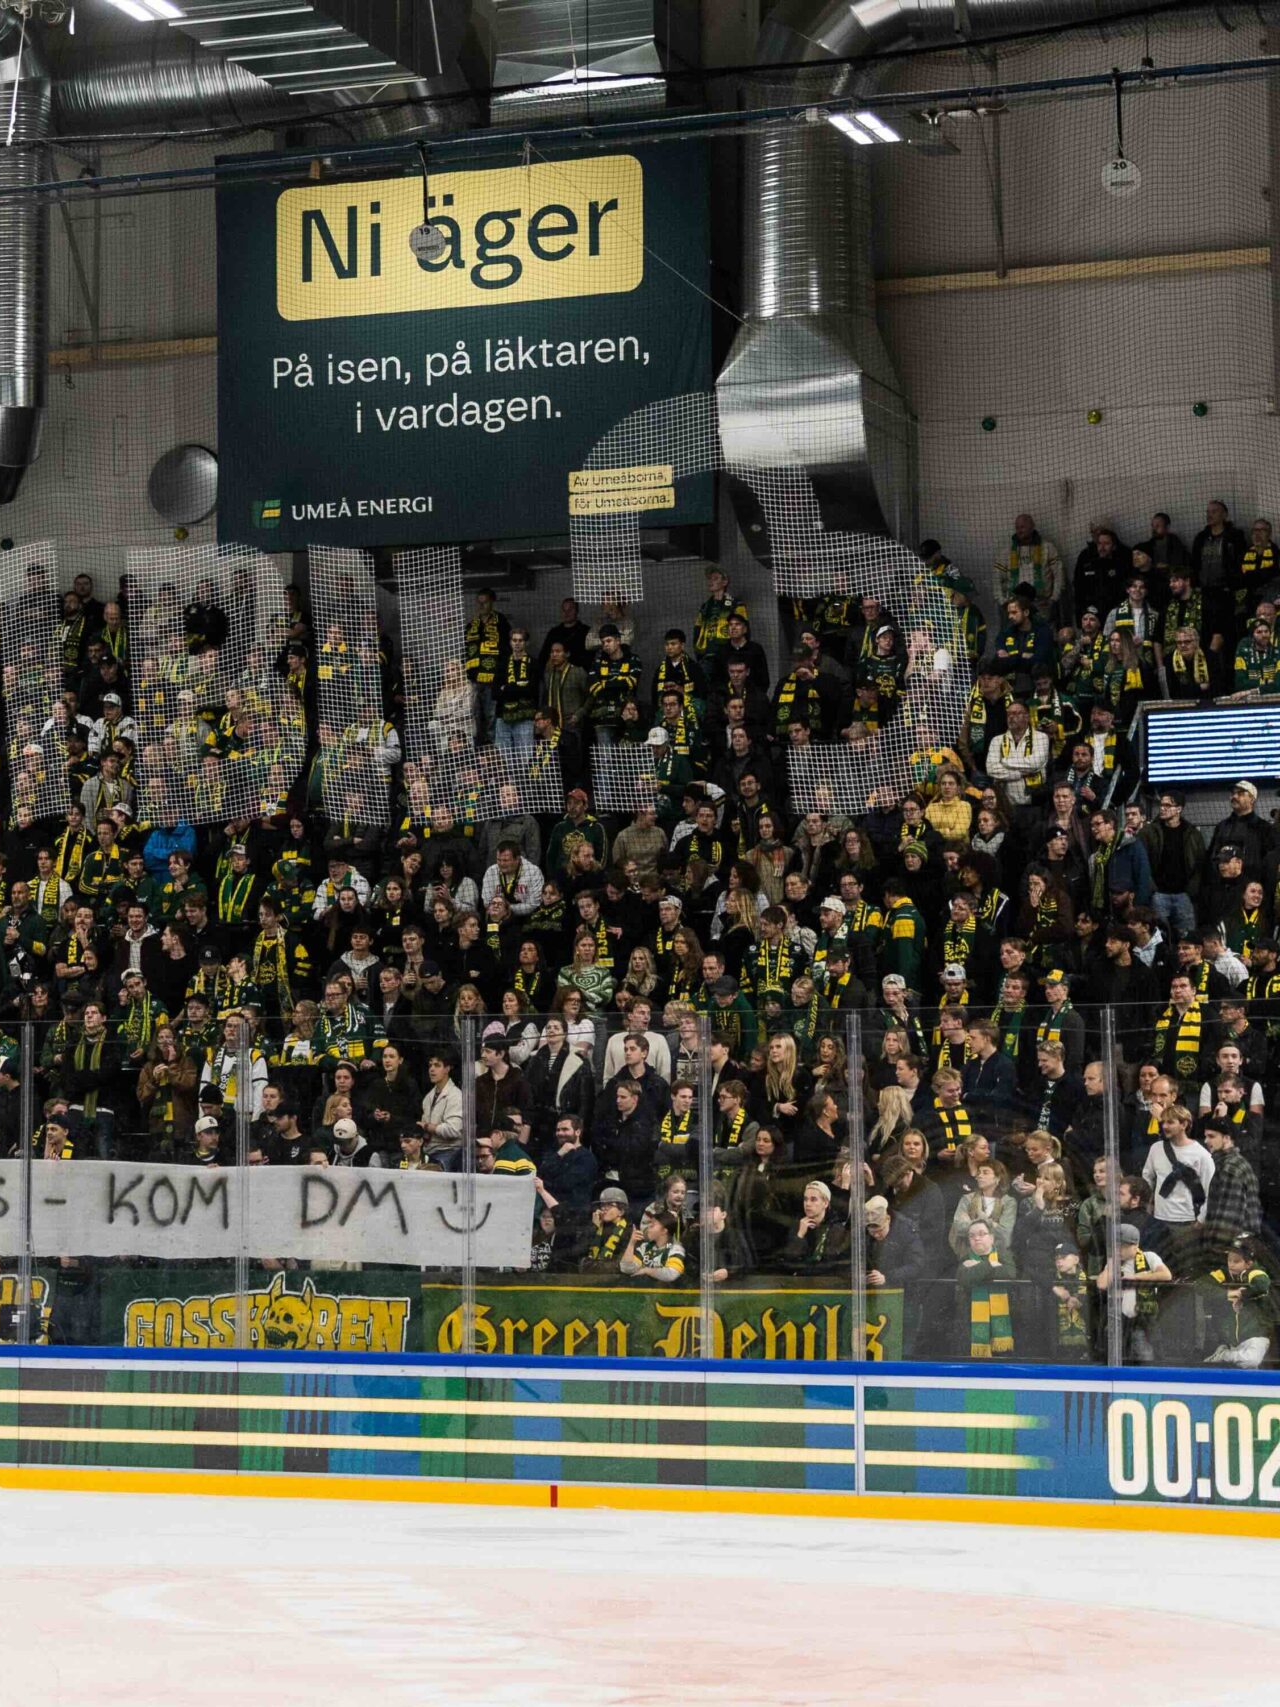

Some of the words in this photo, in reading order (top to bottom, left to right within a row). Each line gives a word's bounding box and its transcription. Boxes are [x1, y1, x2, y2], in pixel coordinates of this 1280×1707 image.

[1112, 161, 1128, 170] 20
[300, 200, 382, 284] Ni
[417, 193, 619, 290] äger
[273, 352, 315, 389] På
[327, 354, 411, 387] isen,
[425, 341, 472, 386] på
[485, 335, 651, 373] läktaren,
[355, 402, 363, 434] i
[375, 392, 563, 434] vardagen.
[573, 475, 589, 488] Av
[574, 496, 591, 510] för
[291, 496, 352, 522] UMEÅ
[356, 496, 434, 518] ENERGI
[105, 1172, 230, 1230] KOM
[300, 1174, 409, 1236] DM
[436, 1302, 631, 1356] Green
[1107, 1398, 1280, 1501] 00:02
